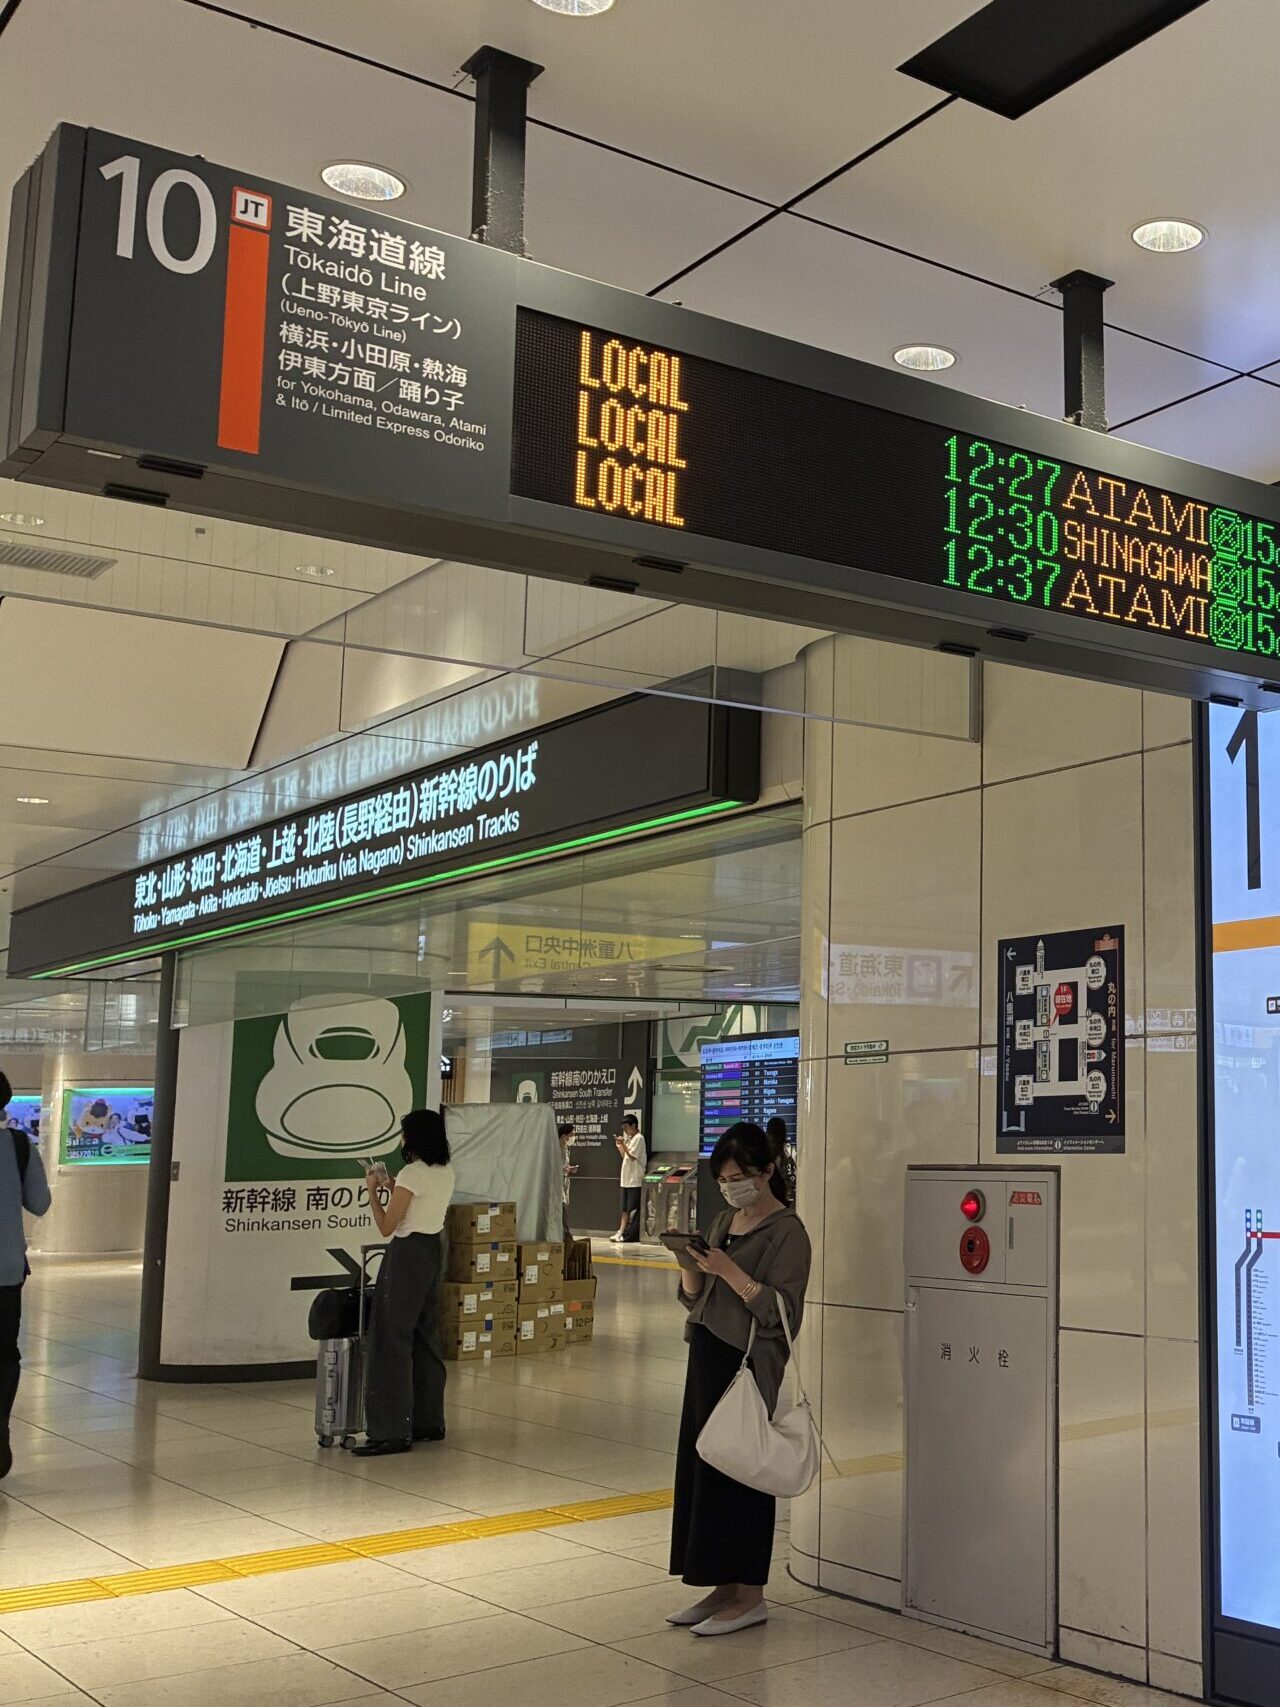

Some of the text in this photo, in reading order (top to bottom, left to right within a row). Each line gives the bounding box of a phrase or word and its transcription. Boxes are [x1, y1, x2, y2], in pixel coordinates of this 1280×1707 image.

[99, 154, 218, 275] 10
[239, 196, 266, 220] JT
[284, 204, 447, 280] 東海道線
[283, 244, 427, 301] Tōkaidō Line
[280, 298, 407, 344] (Ueno-Tōkyō Line)
[278, 348, 465, 412] 伊東方面／踊り子
[279, 320, 469, 388] 横浜・小田原・熱海
[275, 393, 485, 452] & Itō / Limited Express Odoriko
[276, 375, 487, 436] for Yokohama, Odawara, Atami
[579, 331, 689, 411] LOCAL
[943, 434, 1062, 507] 12:27
[1062, 470, 1209, 546] ATAMI
[578, 390, 687, 469] LOCAL
[943, 486, 1060, 557] 12:30
[1064, 519, 1213, 593] SHINAGAWA
[575, 450, 684, 526] LOCAL
[943, 538, 1062, 607] 12:37
[1061, 568, 1209, 638] ATAMI
[339, 852, 357, 881] (via
[359, 835, 404, 875] Nagano)
[407, 821, 474, 860] Shinkansen
[477, 807, 520, 841] Tracks
[550, 1068, 616, 1088] 新幹線南のりかえ口
[579, 1088, 592, 1098] South
[593, 1087, 613, 1097] Transfer
[222, 1186, 296, 1214] 新幹線
[225, 1214, 372, 1233] Shinkansen South
[940, 1342, 1009, 1368] 消火栓
